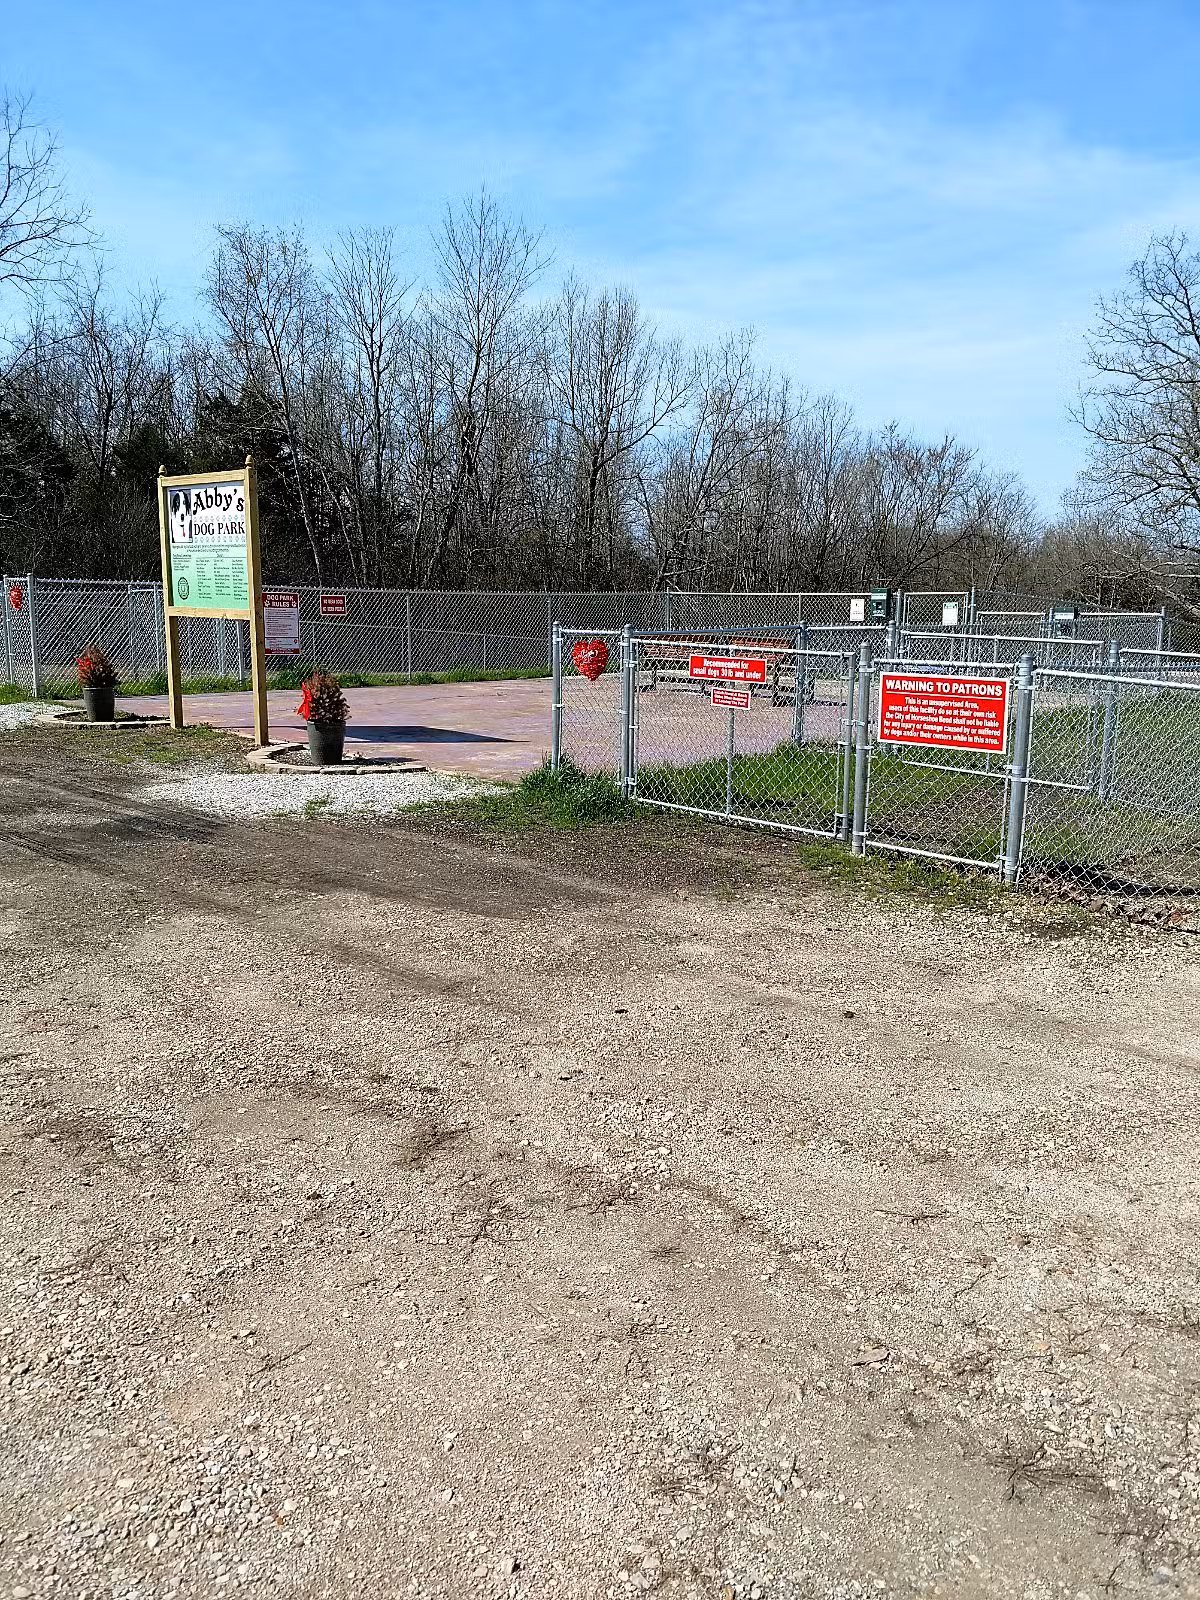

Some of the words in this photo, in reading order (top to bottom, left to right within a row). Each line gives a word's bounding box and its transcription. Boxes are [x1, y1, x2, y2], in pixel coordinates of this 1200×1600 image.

[193, 486, 245, 515] Abby's
[194, 522, 214, 536] DOG
[218, 521, 245, 535] PARK
[703, 658, 741, 669] Recommended
[741, 661, 749, 669] for
[693, 667, 707, 675] small
[707, 667, 720, 677] dogs
[721, 668, 728, 677] 30
[727, 668, 734, 677] lb
[735, 670, 745, 678] and
[746, 671, 761, 679] under
[885, 679, 935, 692] WARNING
[935, 682, 951, 693] TO
[951, 683, 1003, 697] PATRONS
[904, 696, 916, 705] This
[916, 697, 922, 705] is
[928, 699, 965, 708] unsupervised
[964, 701, 979, 710] Area,
[885, 711, 894, 719] the
[894, 711, 905, 722] City
[910, 713, 939, 722] Horseshoe
[938, 716, 953, 724] Bend
[952, 717, 966, 725] shall
[966, 718, 976, 726] not
[983, 719, 1000, 728] liable
[909, 705, 919, 713] this
[919, 705, 938, 716] facility
[959, 709, 973, 717] their
[985, 711, 997, 719] risk
[883, 719, 891, 727] for
[891, 721, 901, 729] any
[900, 721, 916, 730] injury
[922, 723, 943, 732] damage
[963, 727, 971, 735] by
[977, 727, 1001, 736] suffered
[883, 728, 891, 736] by
[890, 728, 903, 737] dogs
[902, 729, 919, 737] and/or
[919, 730, 933, 738] their
[932, 733, 952, 741] owners
[952, 734, 968, 742] while
[967, 735, 974, 743] in
[973, 735, 985, 744] this
